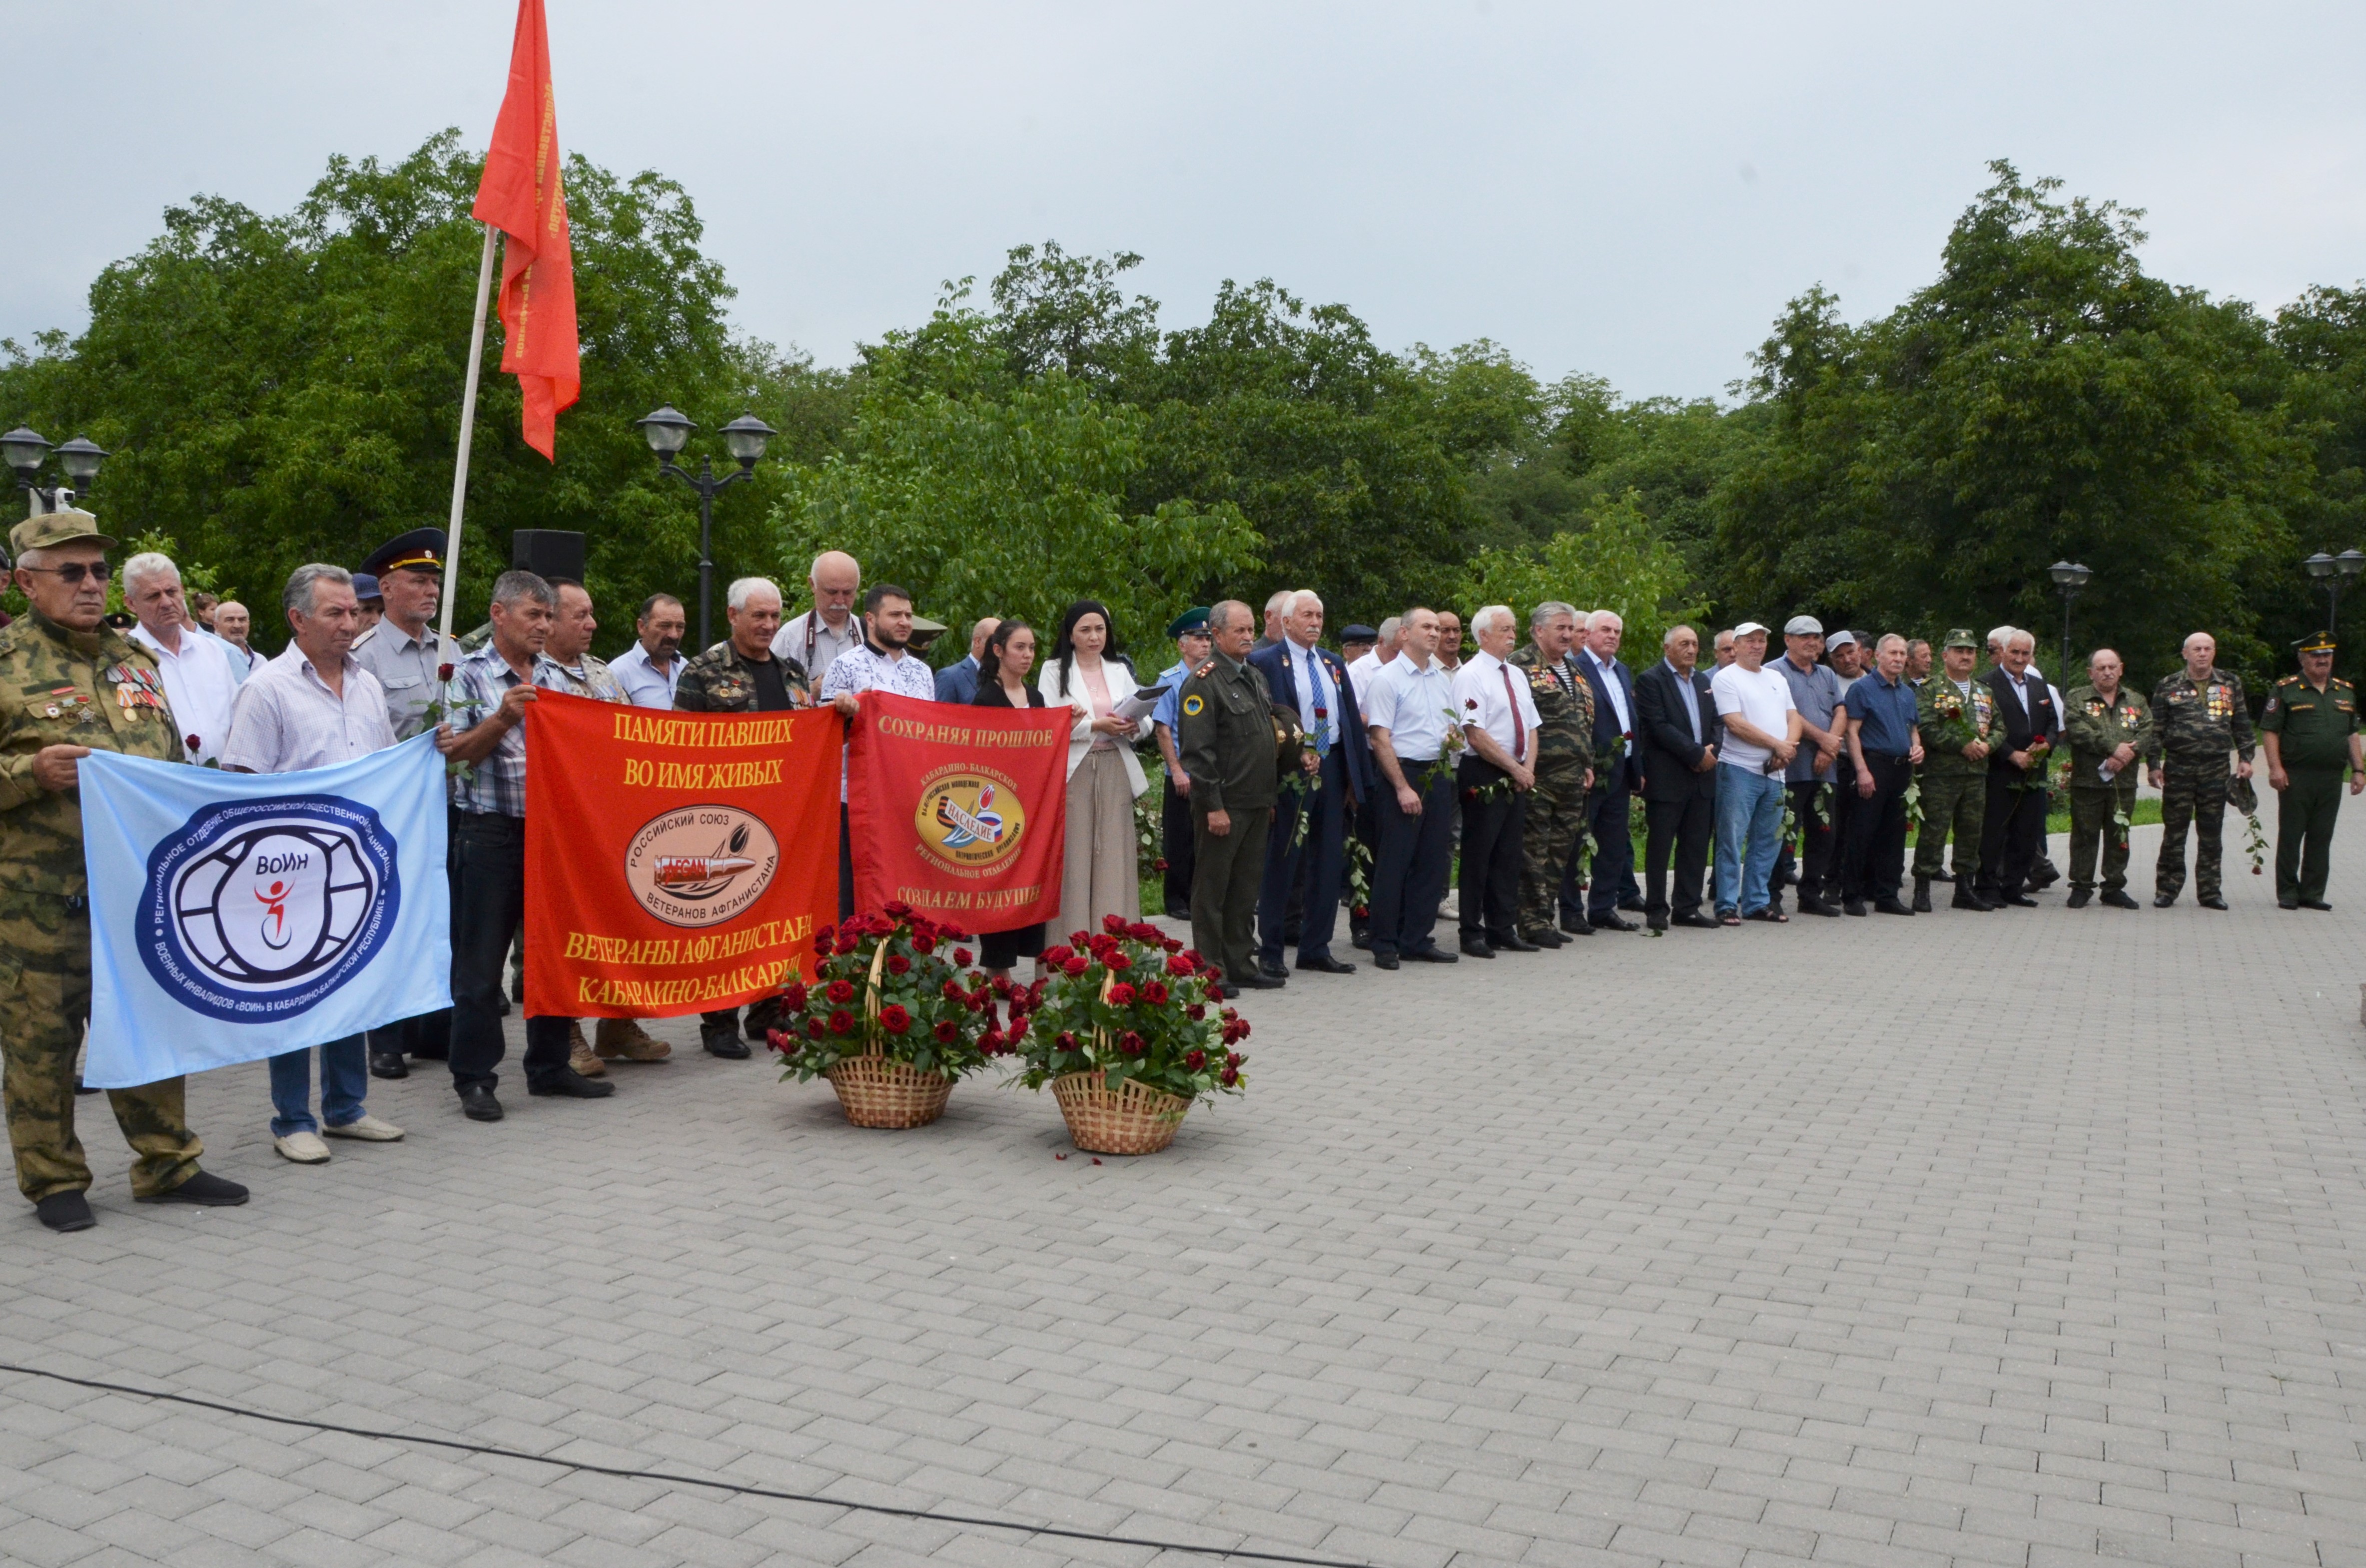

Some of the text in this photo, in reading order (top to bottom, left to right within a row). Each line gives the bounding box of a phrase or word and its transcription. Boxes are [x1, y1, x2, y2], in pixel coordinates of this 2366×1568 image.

[614, 713, 794, 747] ПАМЯТИ ПАВШИХ
[878, 715, 1053, 748] СОХРАНЯЯ ПРОШЛОЕ
[624, 758, 784, 788] ВО ИМЯ ЖИВЫХ
[631, 812, 729, 867] РОССИЙСКИЙ СОЮЗ
[947, 804, 992, 840] НАСЛЕДИЕ
[154, 843, 186, 923] РЕГИОНАЛЬНОЕ
[187, 813, 224, 846] ОТДЕЛЕНИЕ
[222, 801, 305, 819] ОБЩЕРОССИЙСКОЙ
[303, 802, 369, 827] ОБЩЕСТВЕННОЙ
[915, 843, 980, 878] РЕГИОНАЛЬНОЕ
[647, 855, 776, 918] ВЕТЕРАНОВ АФГАНИСТАНА
[897, 884, 1042, 911] СОЗДАЕМ БУДУЩЕЕ
[155, 899, 385, 1012] ВОЕННЫХ ИНВАЛИДОВ «ВОИН» В КАБАРДИНО-БАЛКАРСКОЙ РЕСПУБЛИКЕ
[564, 932, 680, 965] ВЕТЕРАНЫ
